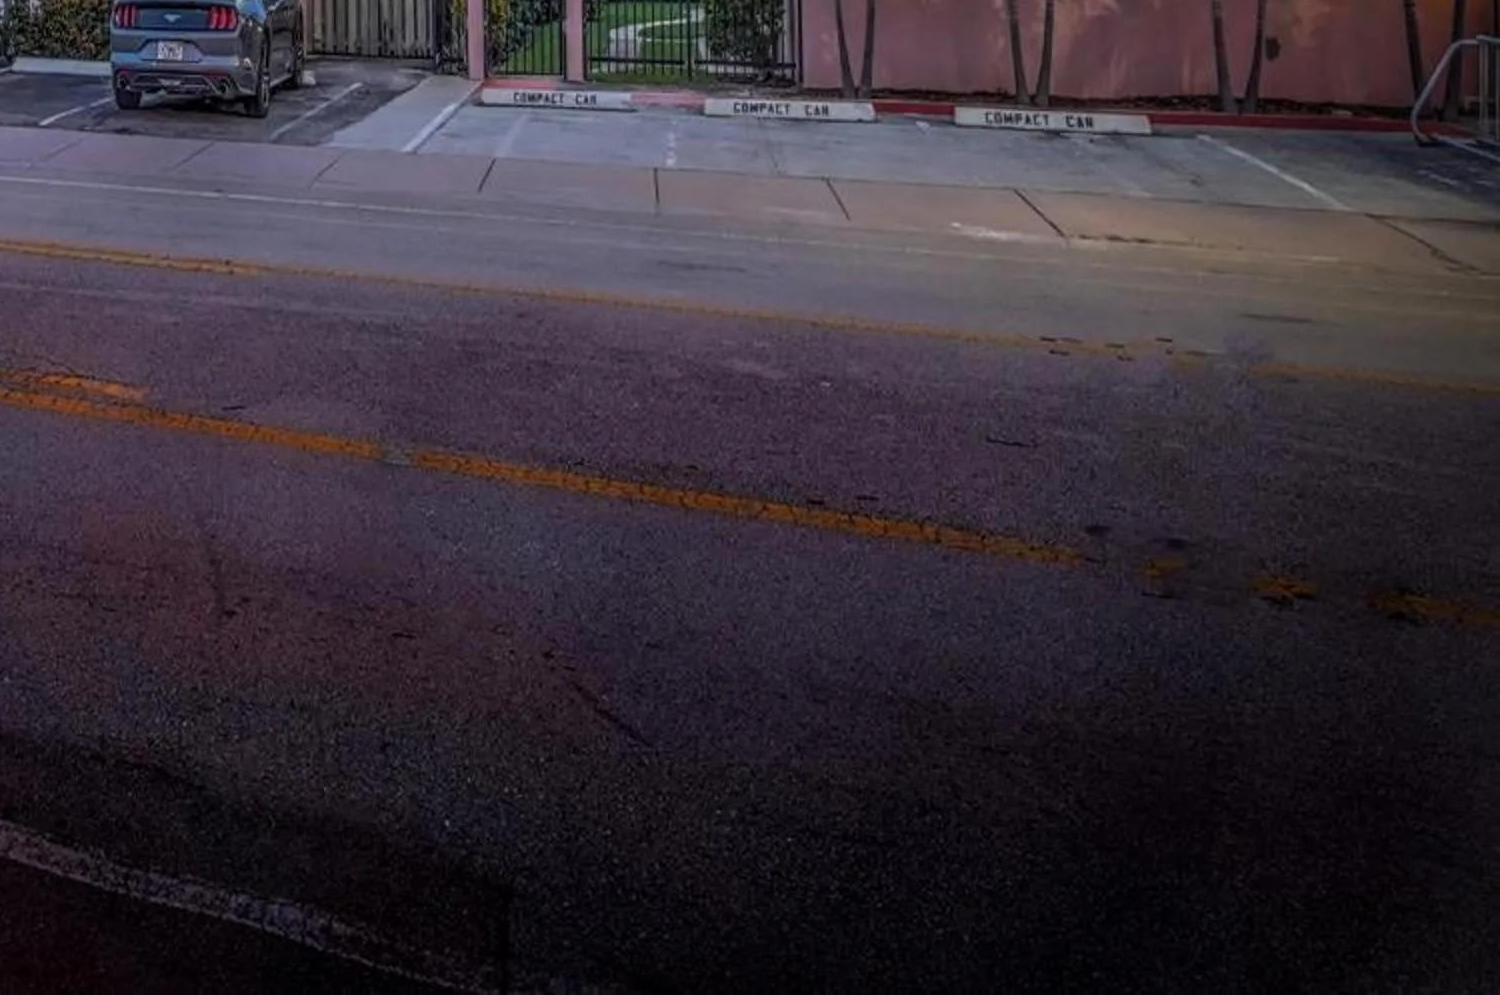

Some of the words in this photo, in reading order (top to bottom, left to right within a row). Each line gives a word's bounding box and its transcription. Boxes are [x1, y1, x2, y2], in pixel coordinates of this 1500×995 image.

[513, 91, 565, 105] COMPACT
[575, 93, 597, 106] CAR
[733, 102, 790, 115] COMPACT
[804, 103, 830, 117] CAR
[984, 111, 1050, 126] COMPACT
[1065, 114, 1094, 129] CAR
